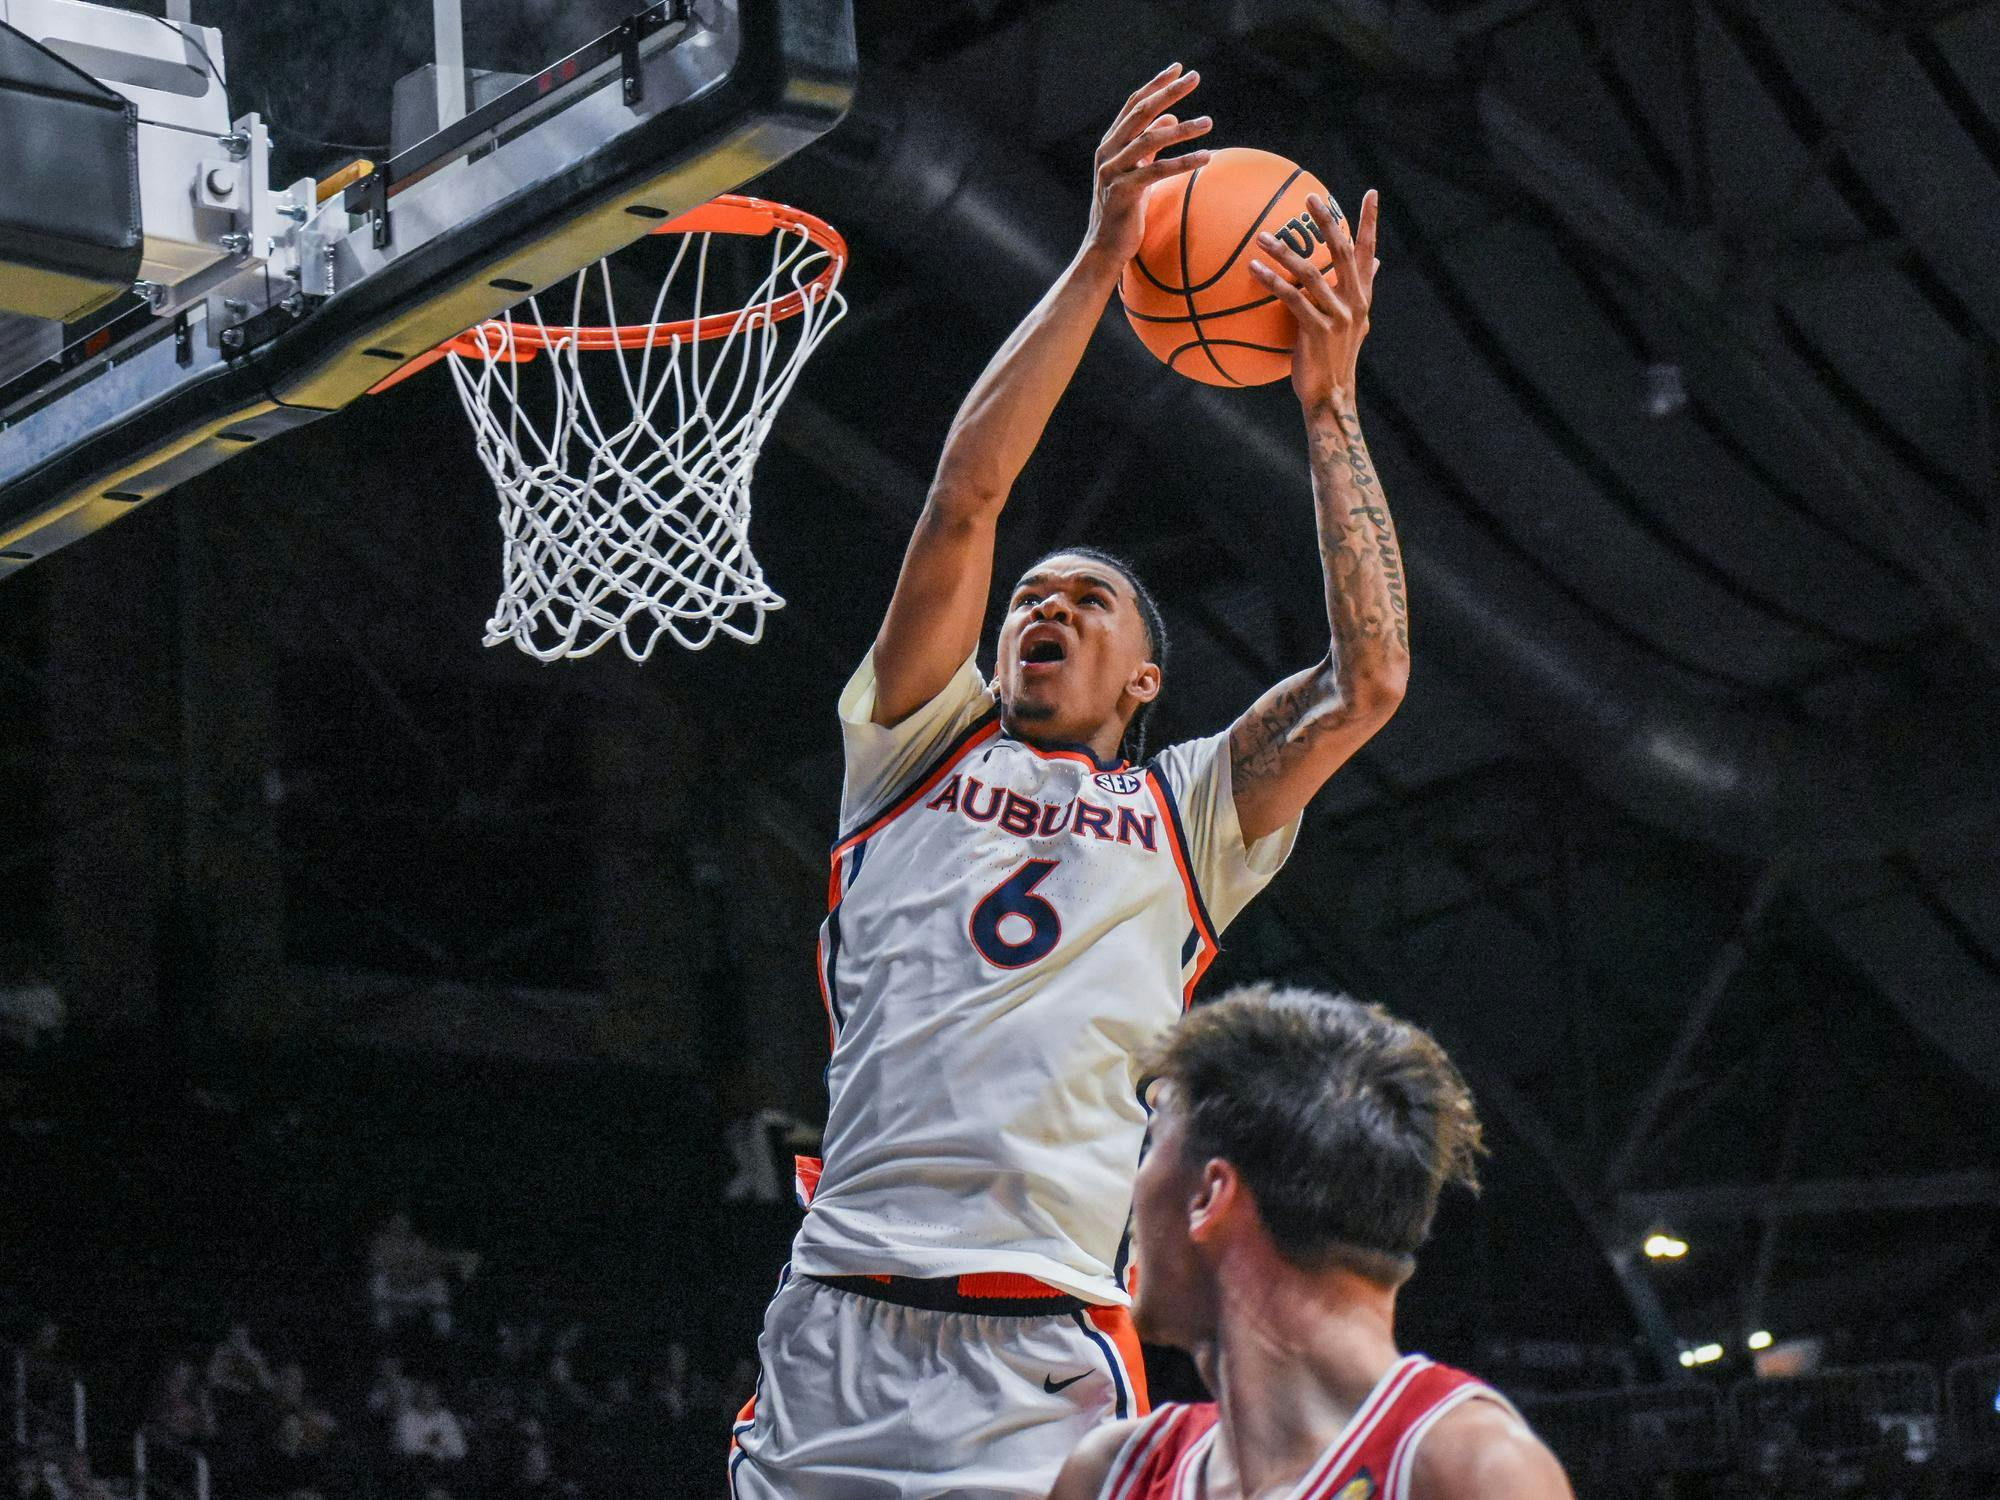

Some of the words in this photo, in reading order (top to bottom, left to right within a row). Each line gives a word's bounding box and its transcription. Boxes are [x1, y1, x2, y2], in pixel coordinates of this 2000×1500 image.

[926, 773, 1158, 853] AUBURN
[1097, 774, 1139, 794] SEC
[969, 857, 1062, 970] 6
